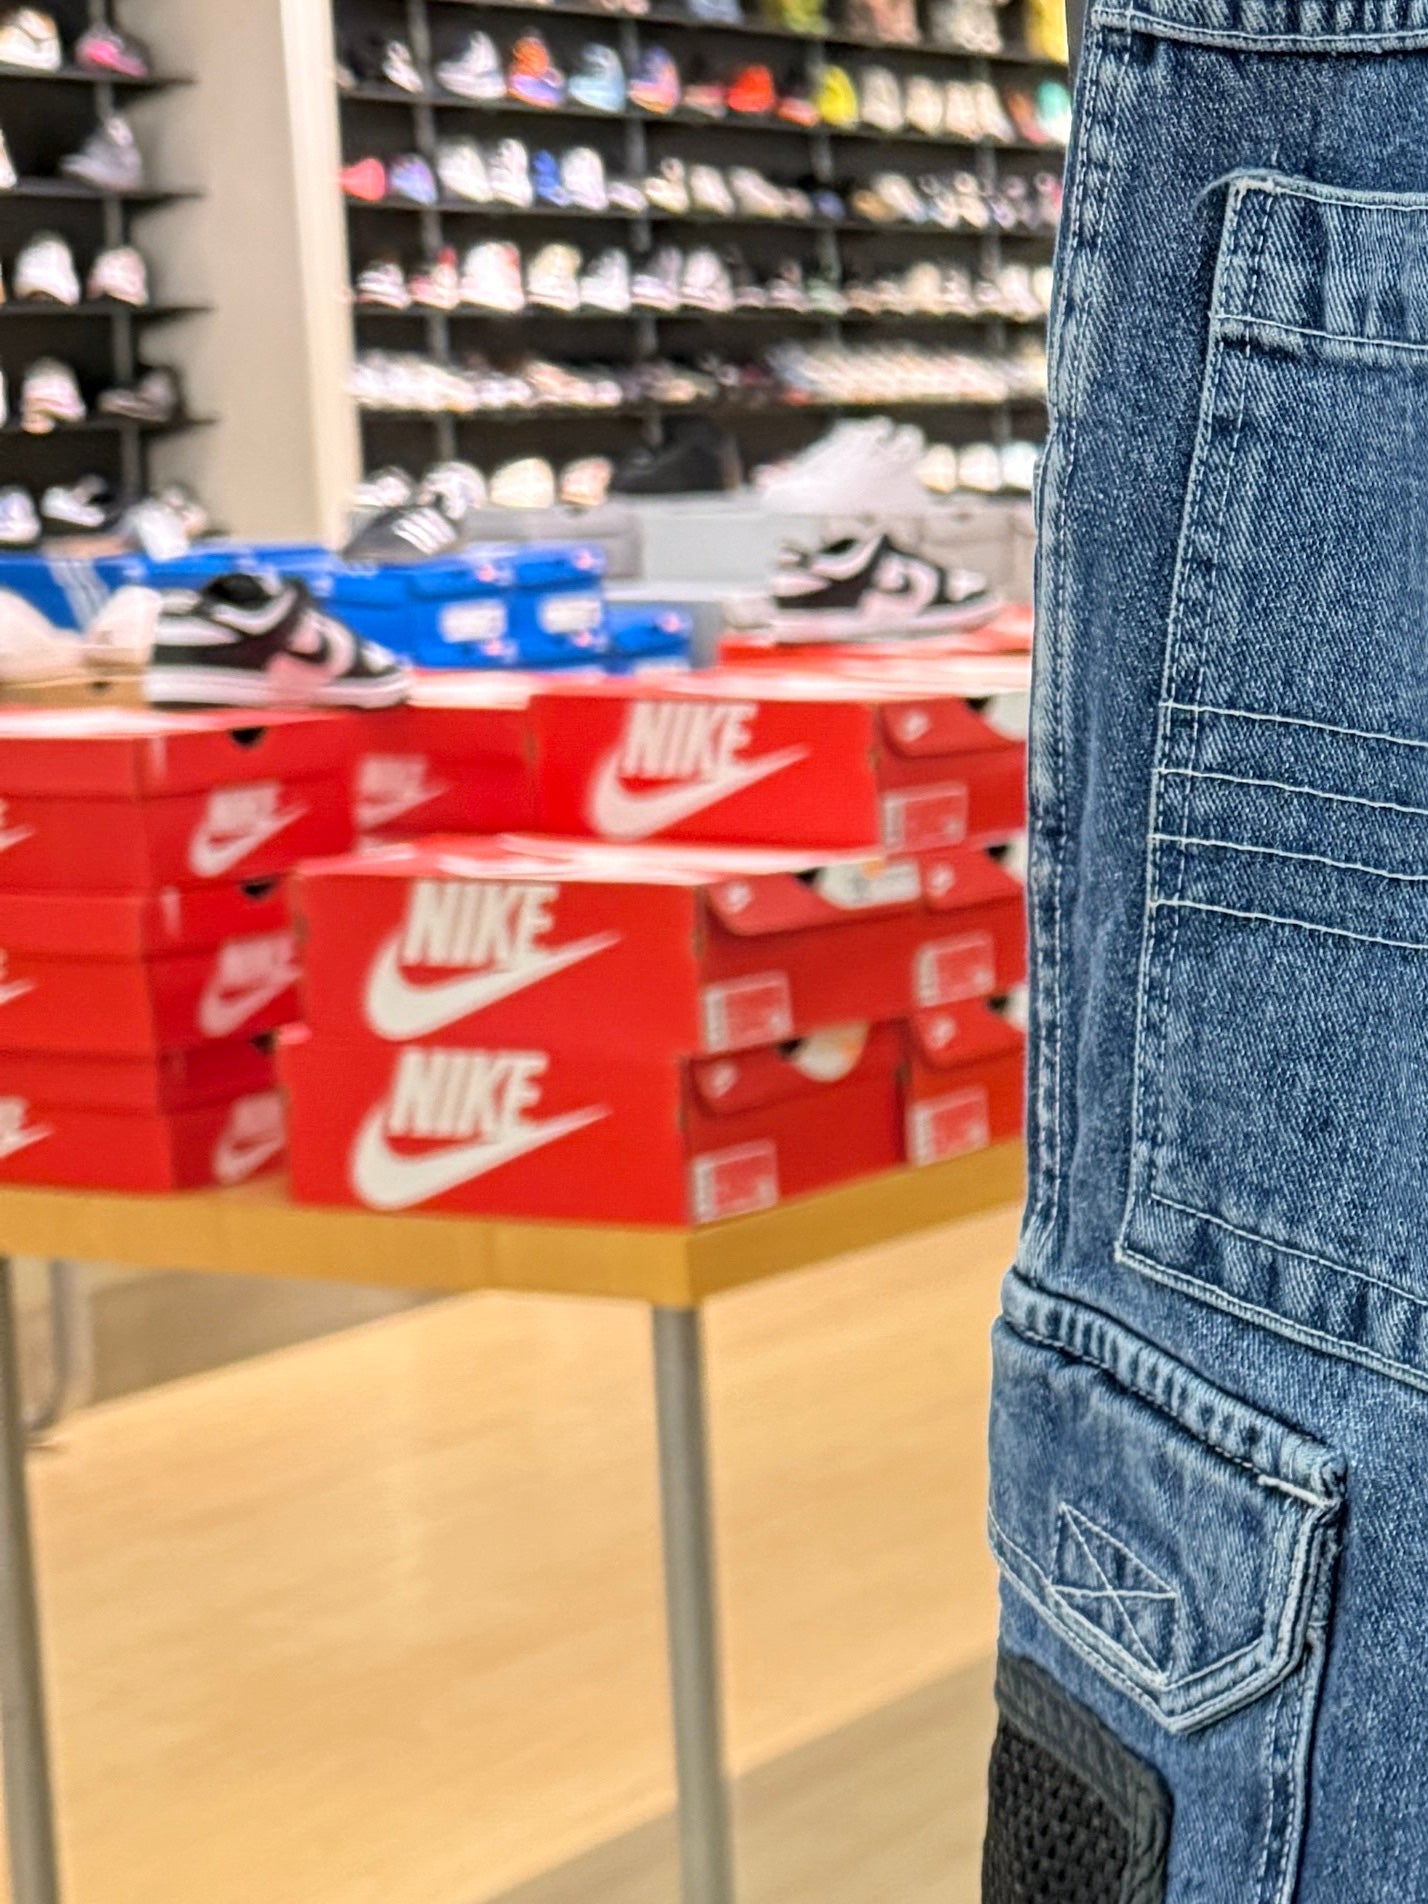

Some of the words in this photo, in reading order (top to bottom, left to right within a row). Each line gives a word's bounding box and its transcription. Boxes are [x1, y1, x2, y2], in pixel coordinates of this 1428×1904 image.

[618, 698, 760, 780] NIKE
[401, 878, 560, 968] NIKE
[387, 1047, 549, 1142] NIKE
